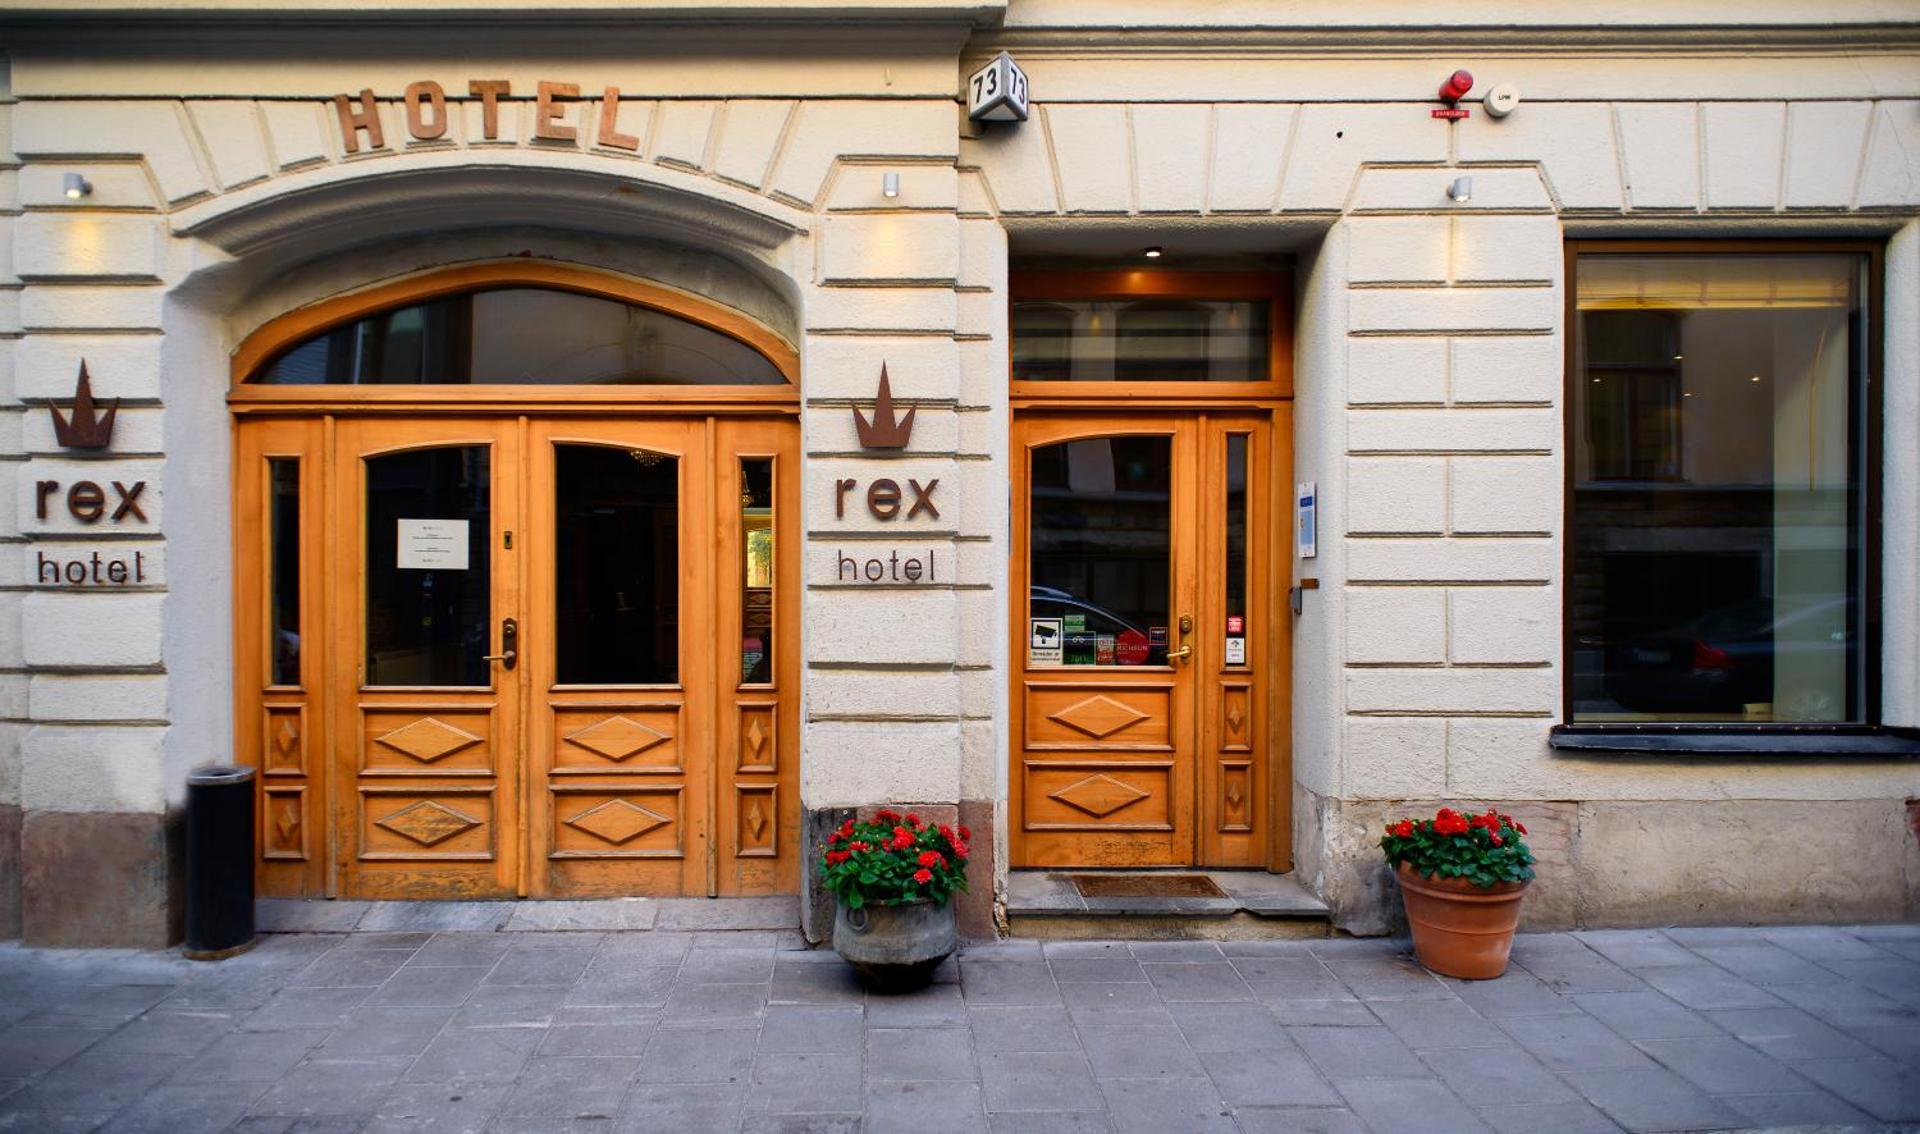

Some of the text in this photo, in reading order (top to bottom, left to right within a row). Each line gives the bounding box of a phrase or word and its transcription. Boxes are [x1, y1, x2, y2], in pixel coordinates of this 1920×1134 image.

[973, 67, 997, 104] 73
[1011, 66, 1025, 104] 73
[334, 80, 639, 153] HOTEL
[35, 480, 148, 523] rex
[836, 478, 940, 520] rex
[37, 551, 143, 583] hotel
[837, 549, 934, 582] hotel
